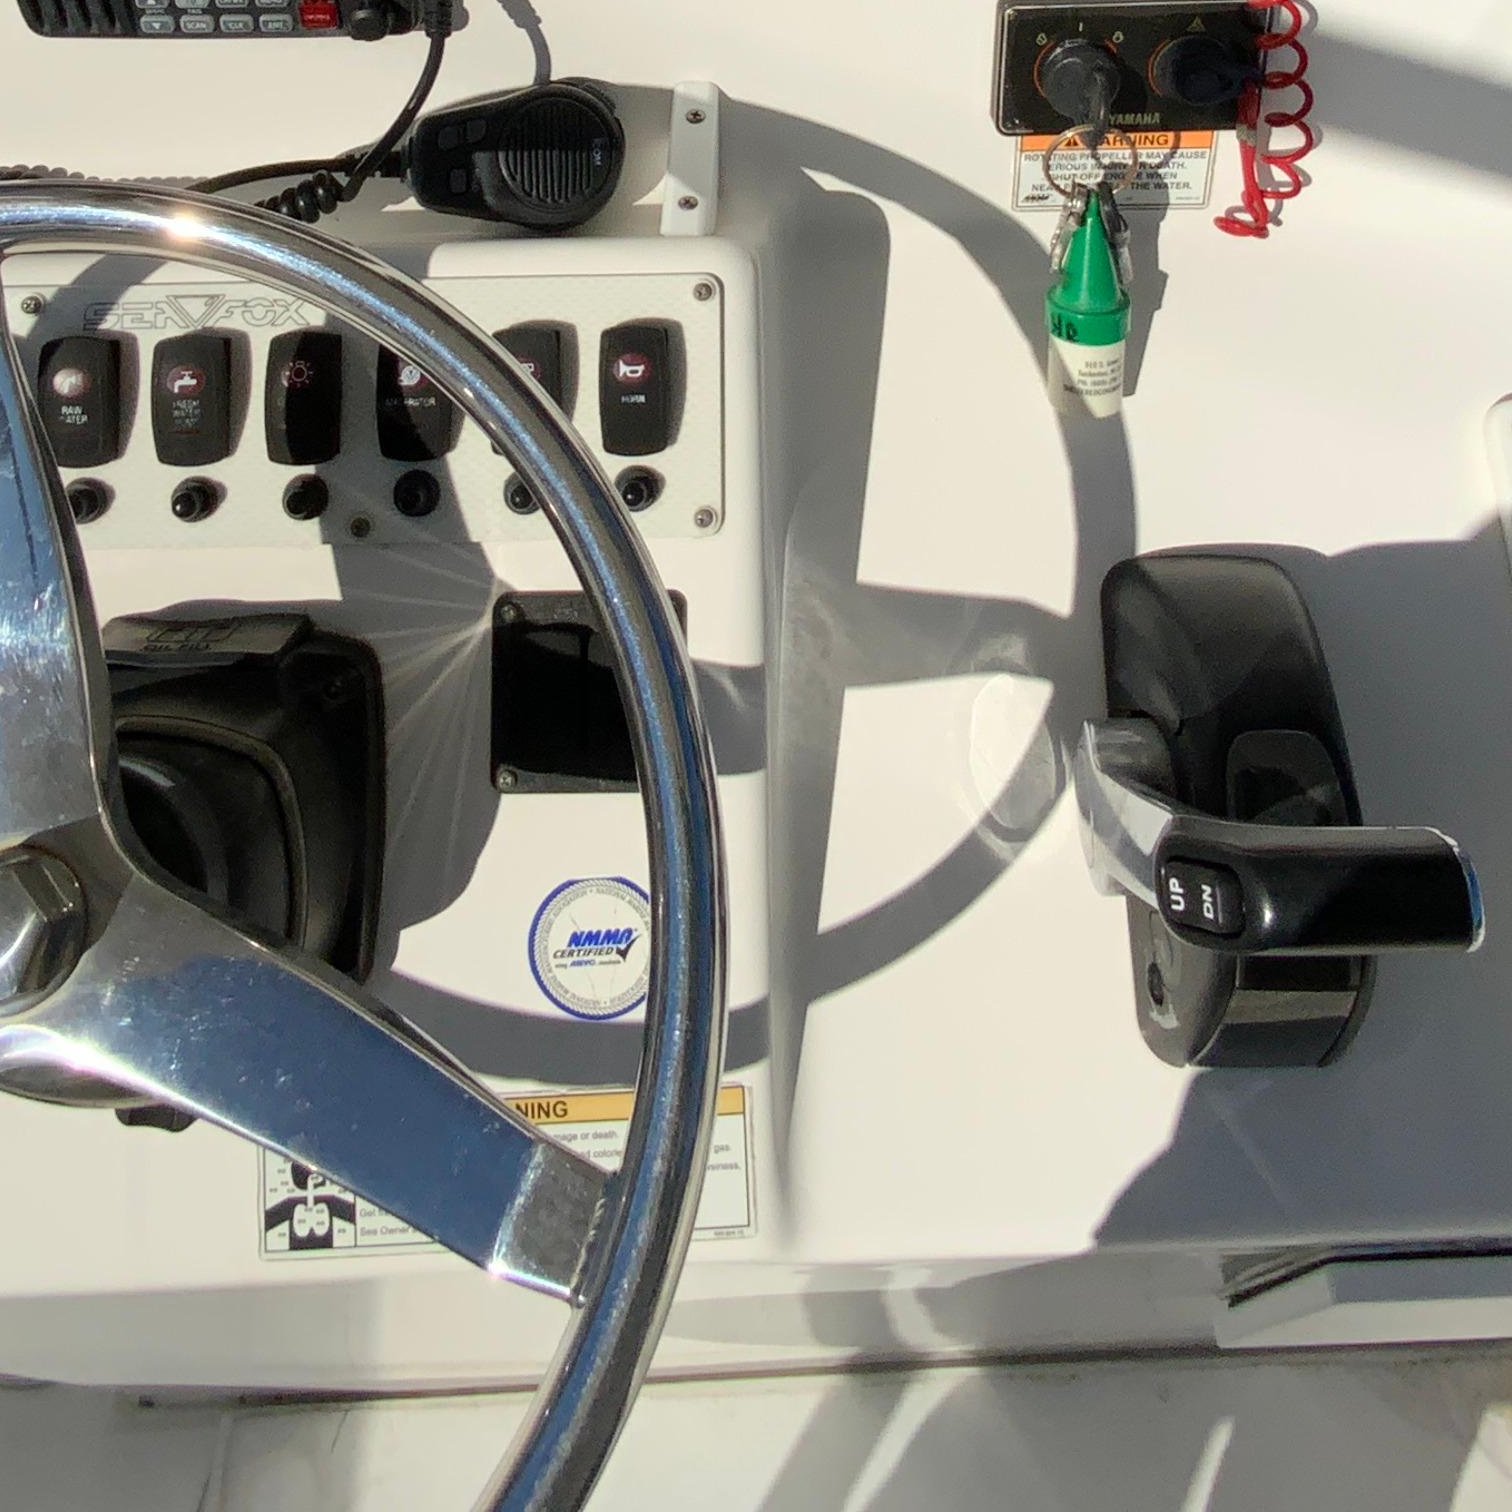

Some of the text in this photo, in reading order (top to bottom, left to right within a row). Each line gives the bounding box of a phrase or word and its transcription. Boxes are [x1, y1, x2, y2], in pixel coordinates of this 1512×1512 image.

[185, 21, 207, 29] SCAN
[1108, 112, 1161, 126] YAMAHA
[1097, 134, 1169, 148] ARNING
[1049, 162, 1089, 171] ERIOUS
[1079, 171, 1101, 181] OFF
[1031, 183, 1055, 192] NEA
[61, 405, 83, 414] RAW
[60, 413, 88, 424] ATER
[1169, 877, 1185, 911] UP
[1201, 883, 1214, 920] DN
[567, 927, 633, 948] NMMA
[553, 946, 614, 959] CERTIFIED
